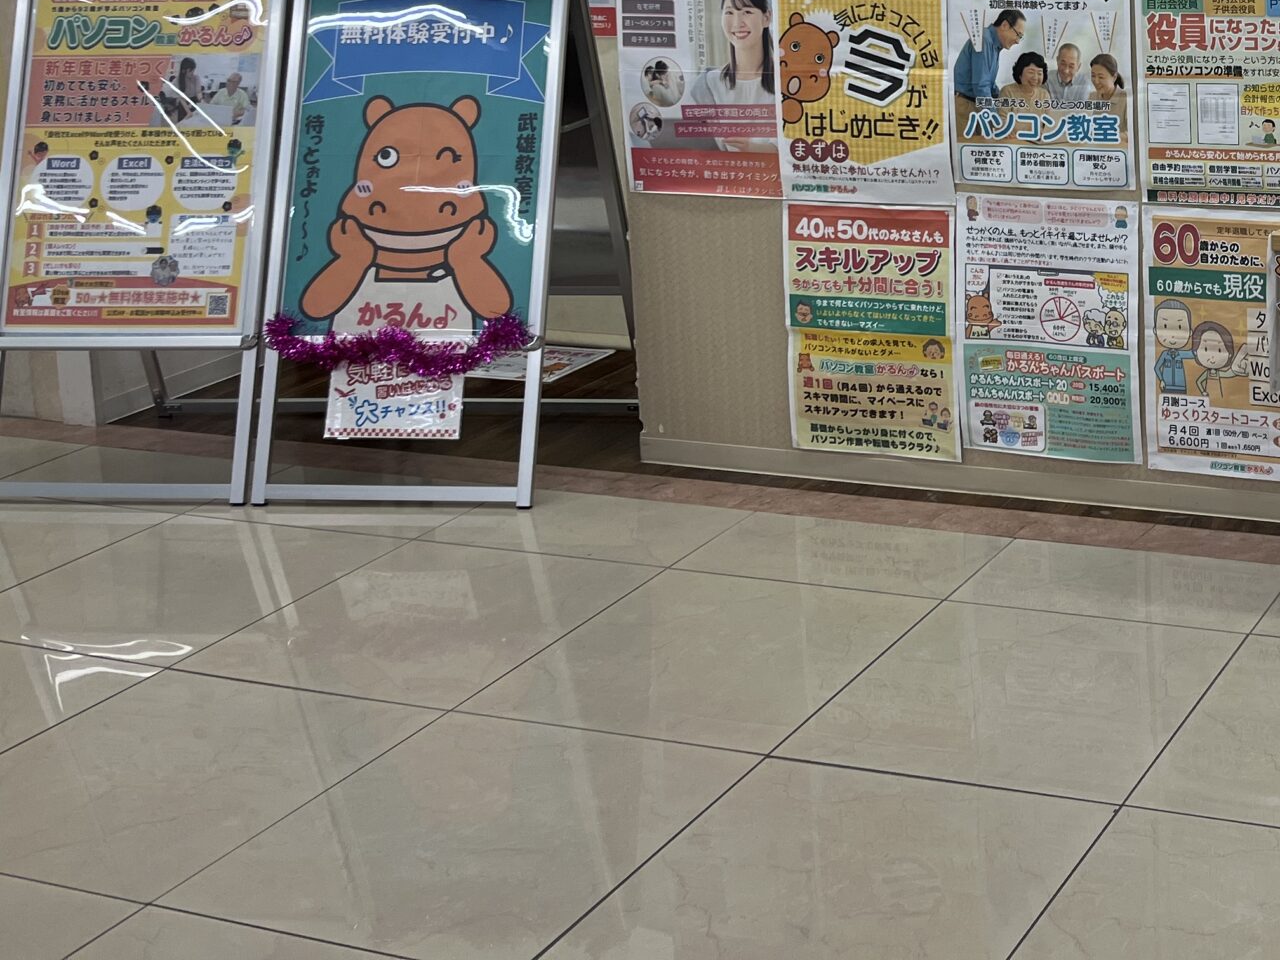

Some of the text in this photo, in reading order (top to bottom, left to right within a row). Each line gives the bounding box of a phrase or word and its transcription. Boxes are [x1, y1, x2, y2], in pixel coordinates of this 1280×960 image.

[1213, 4, 1256, 15] 子供会役員
[1147, 13, 1208, 50] 役員
[964, 111, 1120, 144] パソコン教室
[794, 141, 846, 158] まずは
[51, 159, 76, 168] Word
[122, 159, 148, 167] Excel
[1079, 155, 1120, 163] 月謝制だから
[1152, 163, 1180, 172] 自由予約
[1153, 221, 1200, 266] 60
[795, 246, 941, 276] スキルアップ
[1056, 379, 1067, 391] 20
[1046, 392, 1070, 404] GOLD
[1162, 397, 1206, 408] 月謝コース
